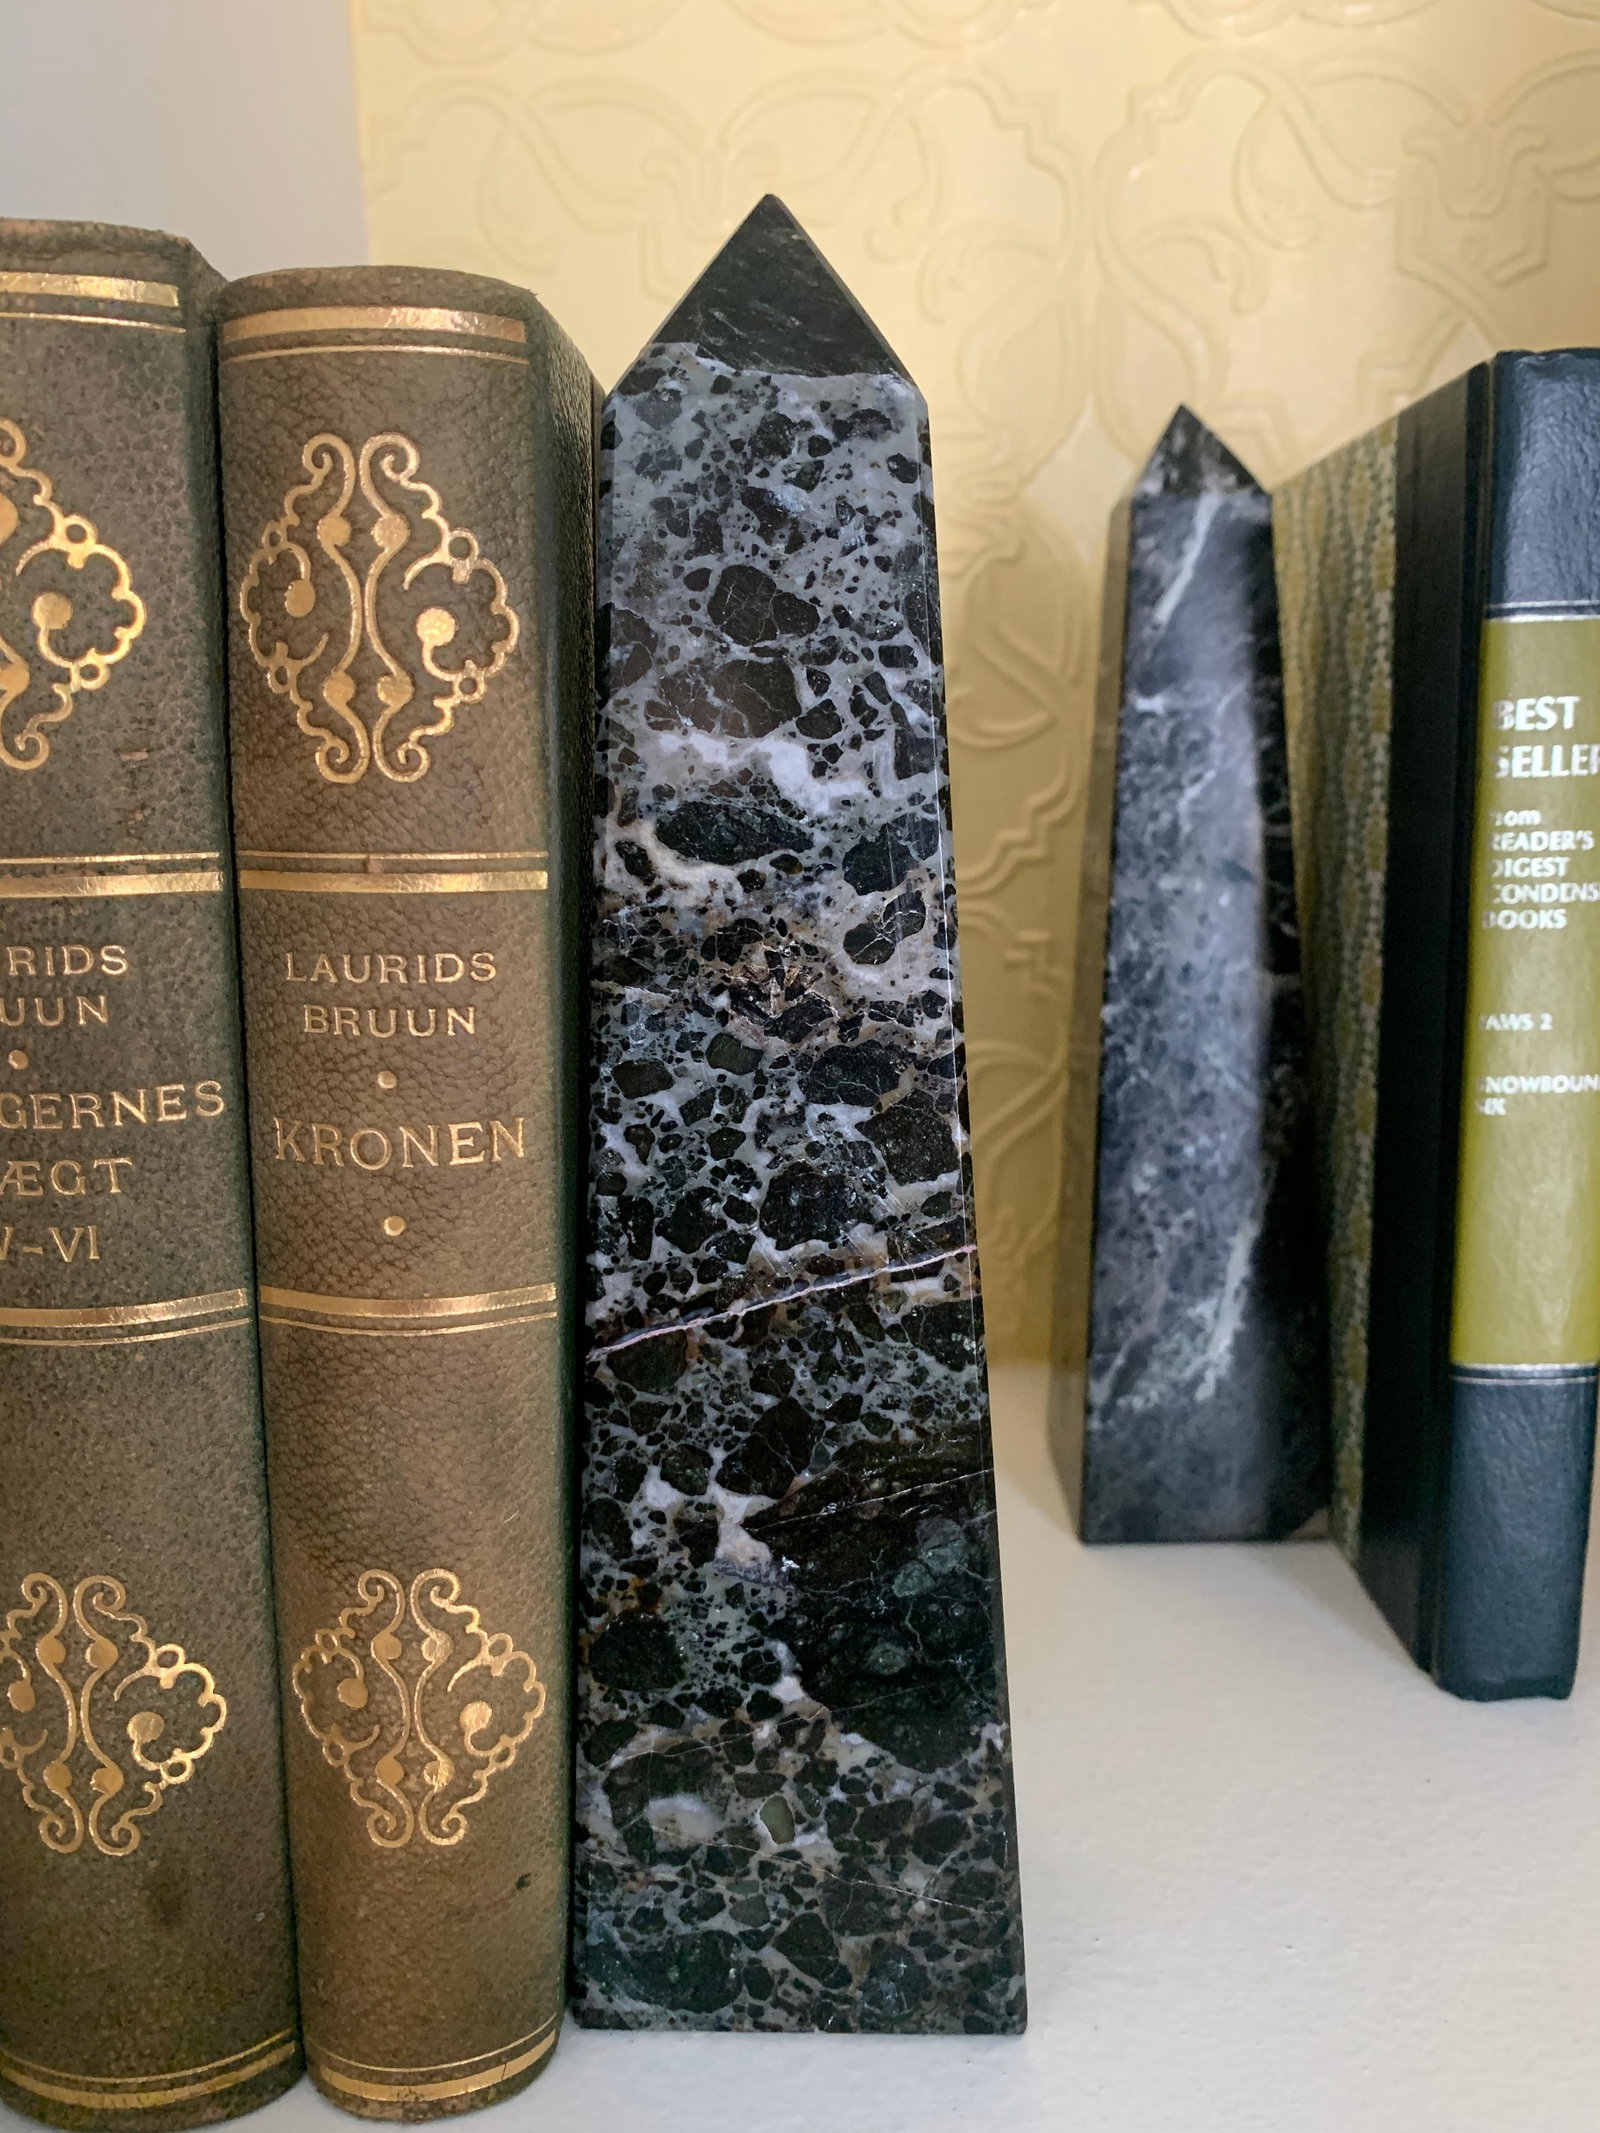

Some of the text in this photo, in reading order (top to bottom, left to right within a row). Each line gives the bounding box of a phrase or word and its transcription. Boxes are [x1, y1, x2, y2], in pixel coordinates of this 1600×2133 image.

[1493, 696, 1580, 731] BEST
[1493, 882, 1600, 904] ONDENS
[6, 945, 129, 976] RIDS
[286, 951, 497, 984] LAURIDS
[303, 1004, 476, 1038] BRUUN
[1481, 1012, 1553, 1031] AWS 2
[1482, 1074, 1600, 1094] NOWBOUN
[0, 1080, 225, 1130] GERNES
[274, 1117, 525, 1170] KRONEN
